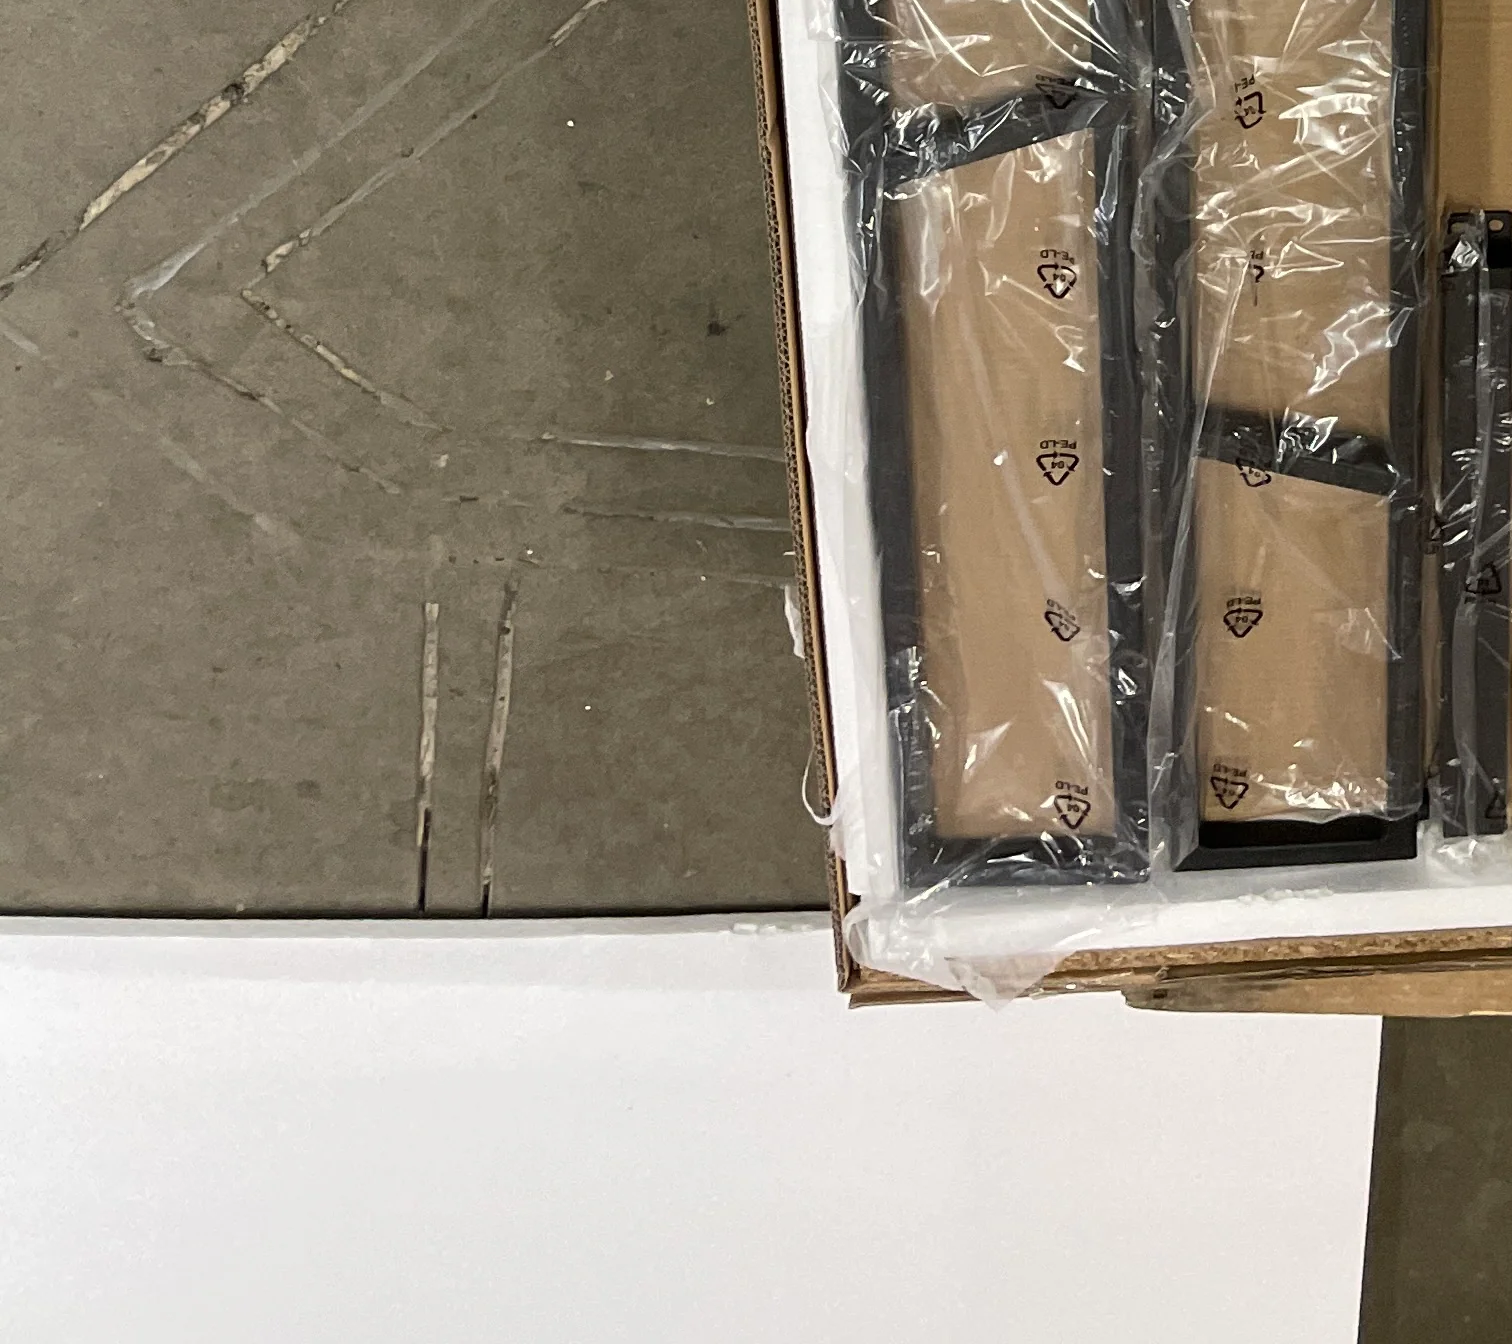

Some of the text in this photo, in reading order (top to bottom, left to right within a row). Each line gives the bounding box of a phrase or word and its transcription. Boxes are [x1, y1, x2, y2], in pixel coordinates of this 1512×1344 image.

[1039, 248, 1075, 266] PE-LD
[1052, 272, 1066, 283] 04
[1039, 439, 1078, 450] PE-LD
[1050, 460, 1065, 470] 04
[1226, 596, 1262, 608] PE-LD
[1235, 615, 1249, 624] 04
[1212, 763, 1248, 778] PE-LD
[1055, 780, 1089, 796] PE-LD
